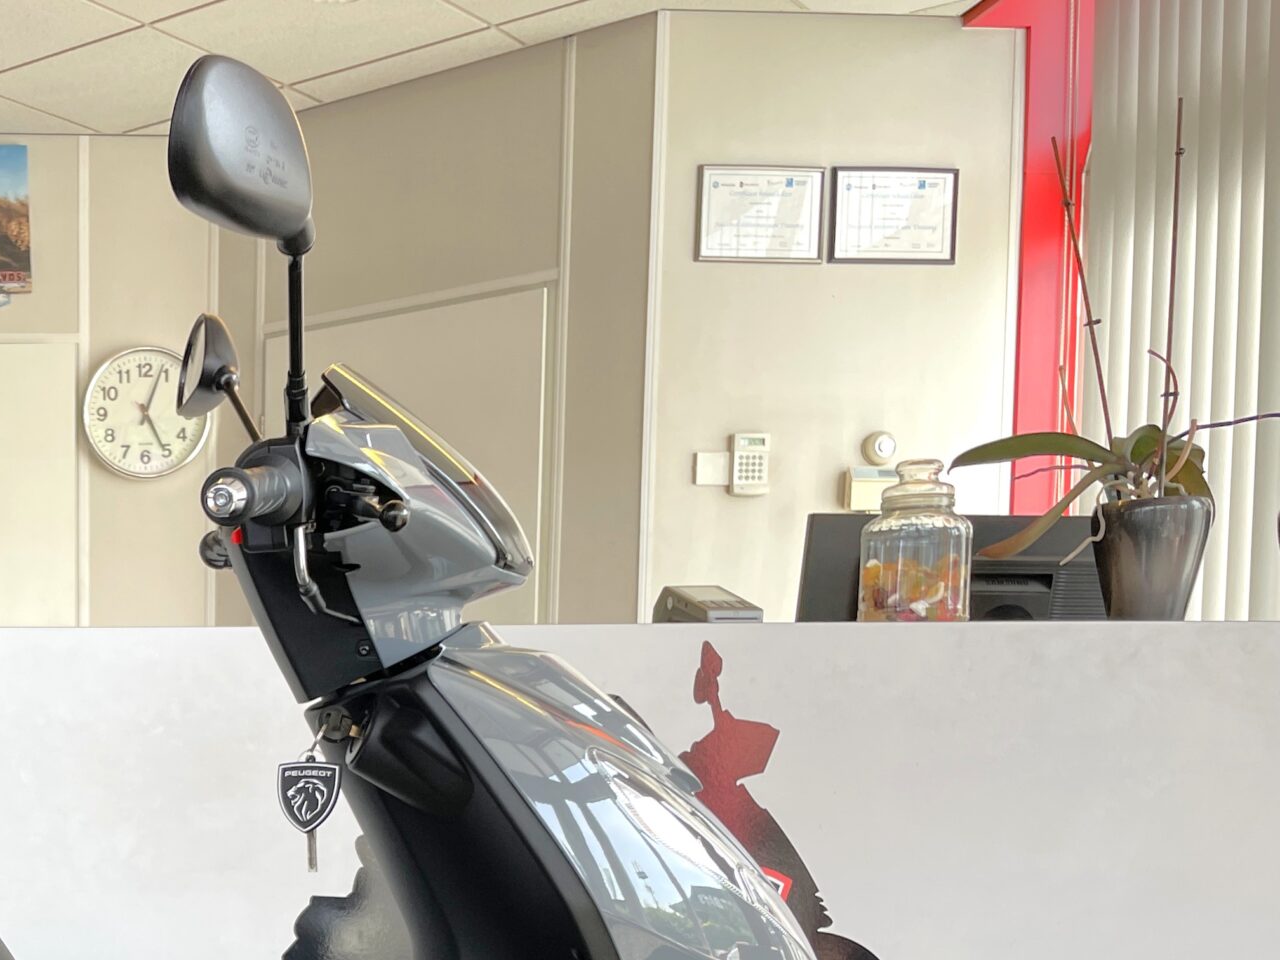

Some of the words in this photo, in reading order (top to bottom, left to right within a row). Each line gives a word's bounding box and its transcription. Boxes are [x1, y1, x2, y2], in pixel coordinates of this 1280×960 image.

[117, 369, 131, 384] 11
[136, 362, 154, 378] 12
[163, 368, 169, 383] 1
[101, 386, 118, 401] 10
[96, 406, 108, 422] 9
[104, 428, 115, 443] 8
[176, 427, 188, 442] 4
[120, 444, 131, 459] 7
[140, 449, 151, 465] 6
[161, 444, 172, 458] 5
[284, 769, 333, 777] PEUGEOT
